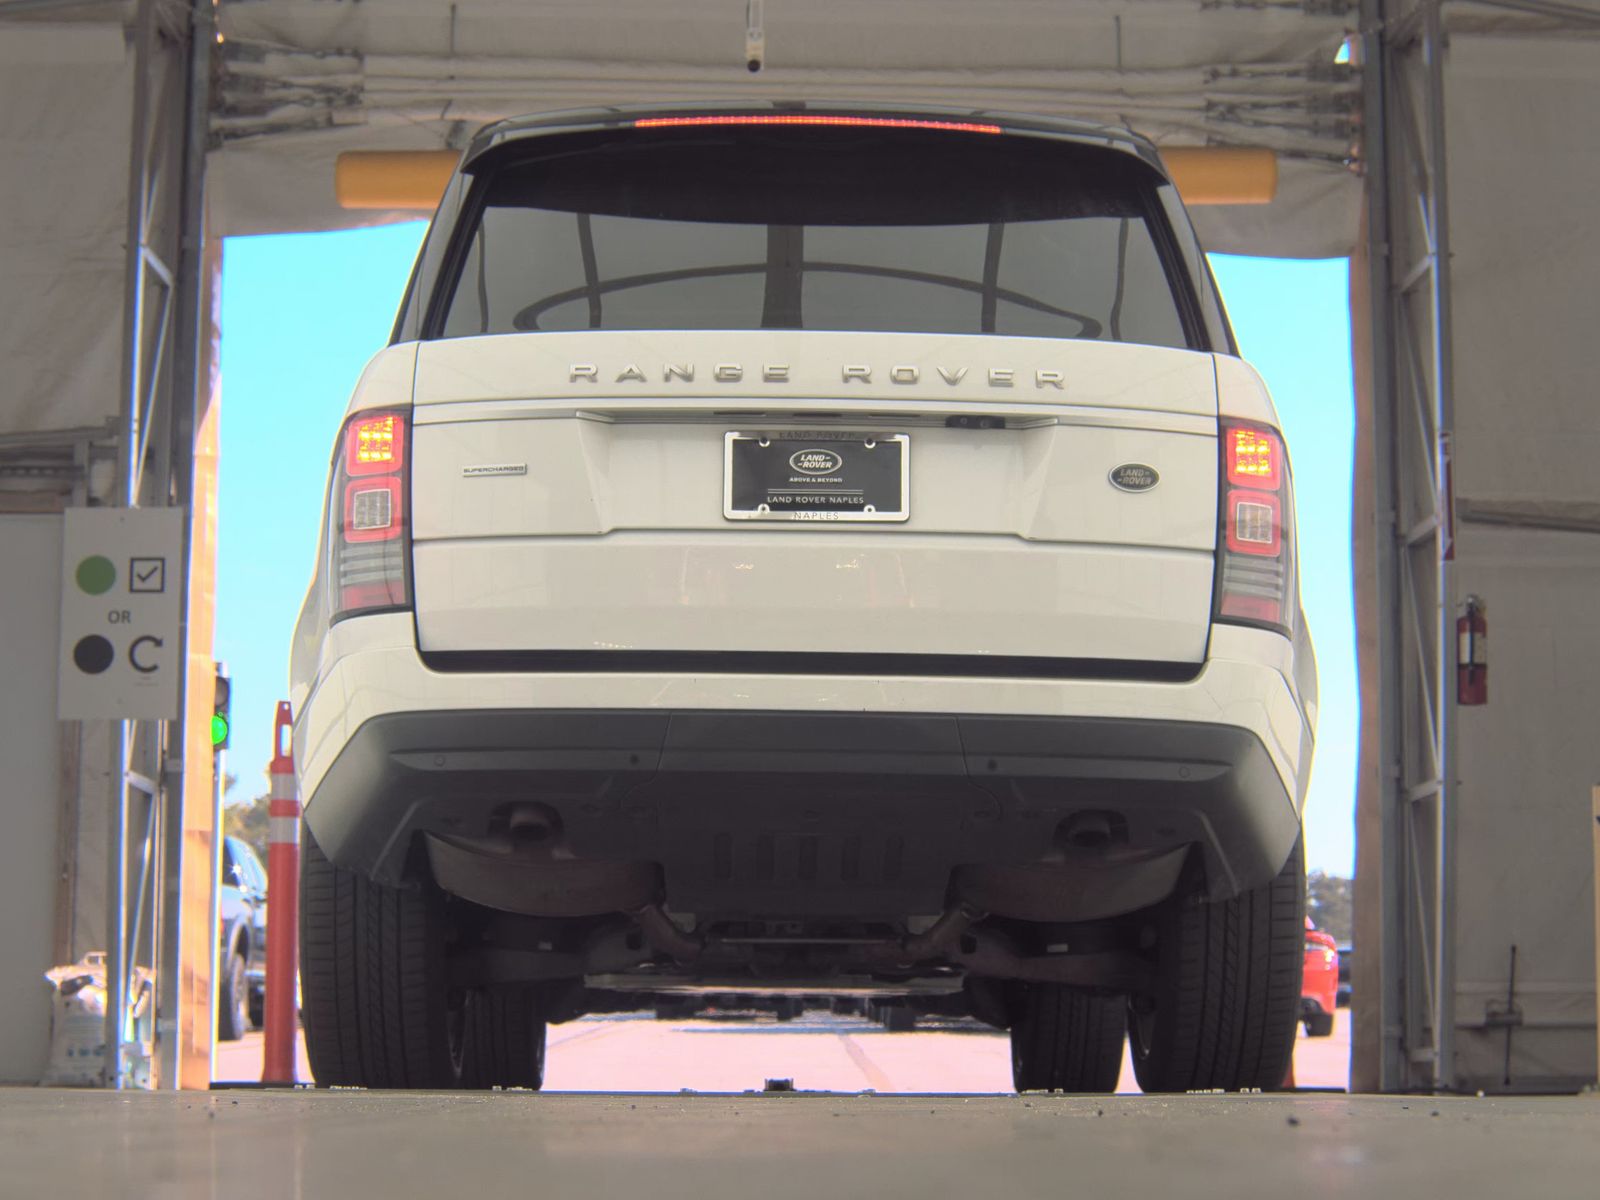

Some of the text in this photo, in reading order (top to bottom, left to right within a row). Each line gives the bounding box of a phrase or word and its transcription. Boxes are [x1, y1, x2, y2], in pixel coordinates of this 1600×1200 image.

[569, 362, 1065, 389] RANGE ROVER
[767, 496, 864, 504] LAND ROVER NAPLES
[793, 511, 840, 520] NAPLES
[108, 610, 131, 624] OR
